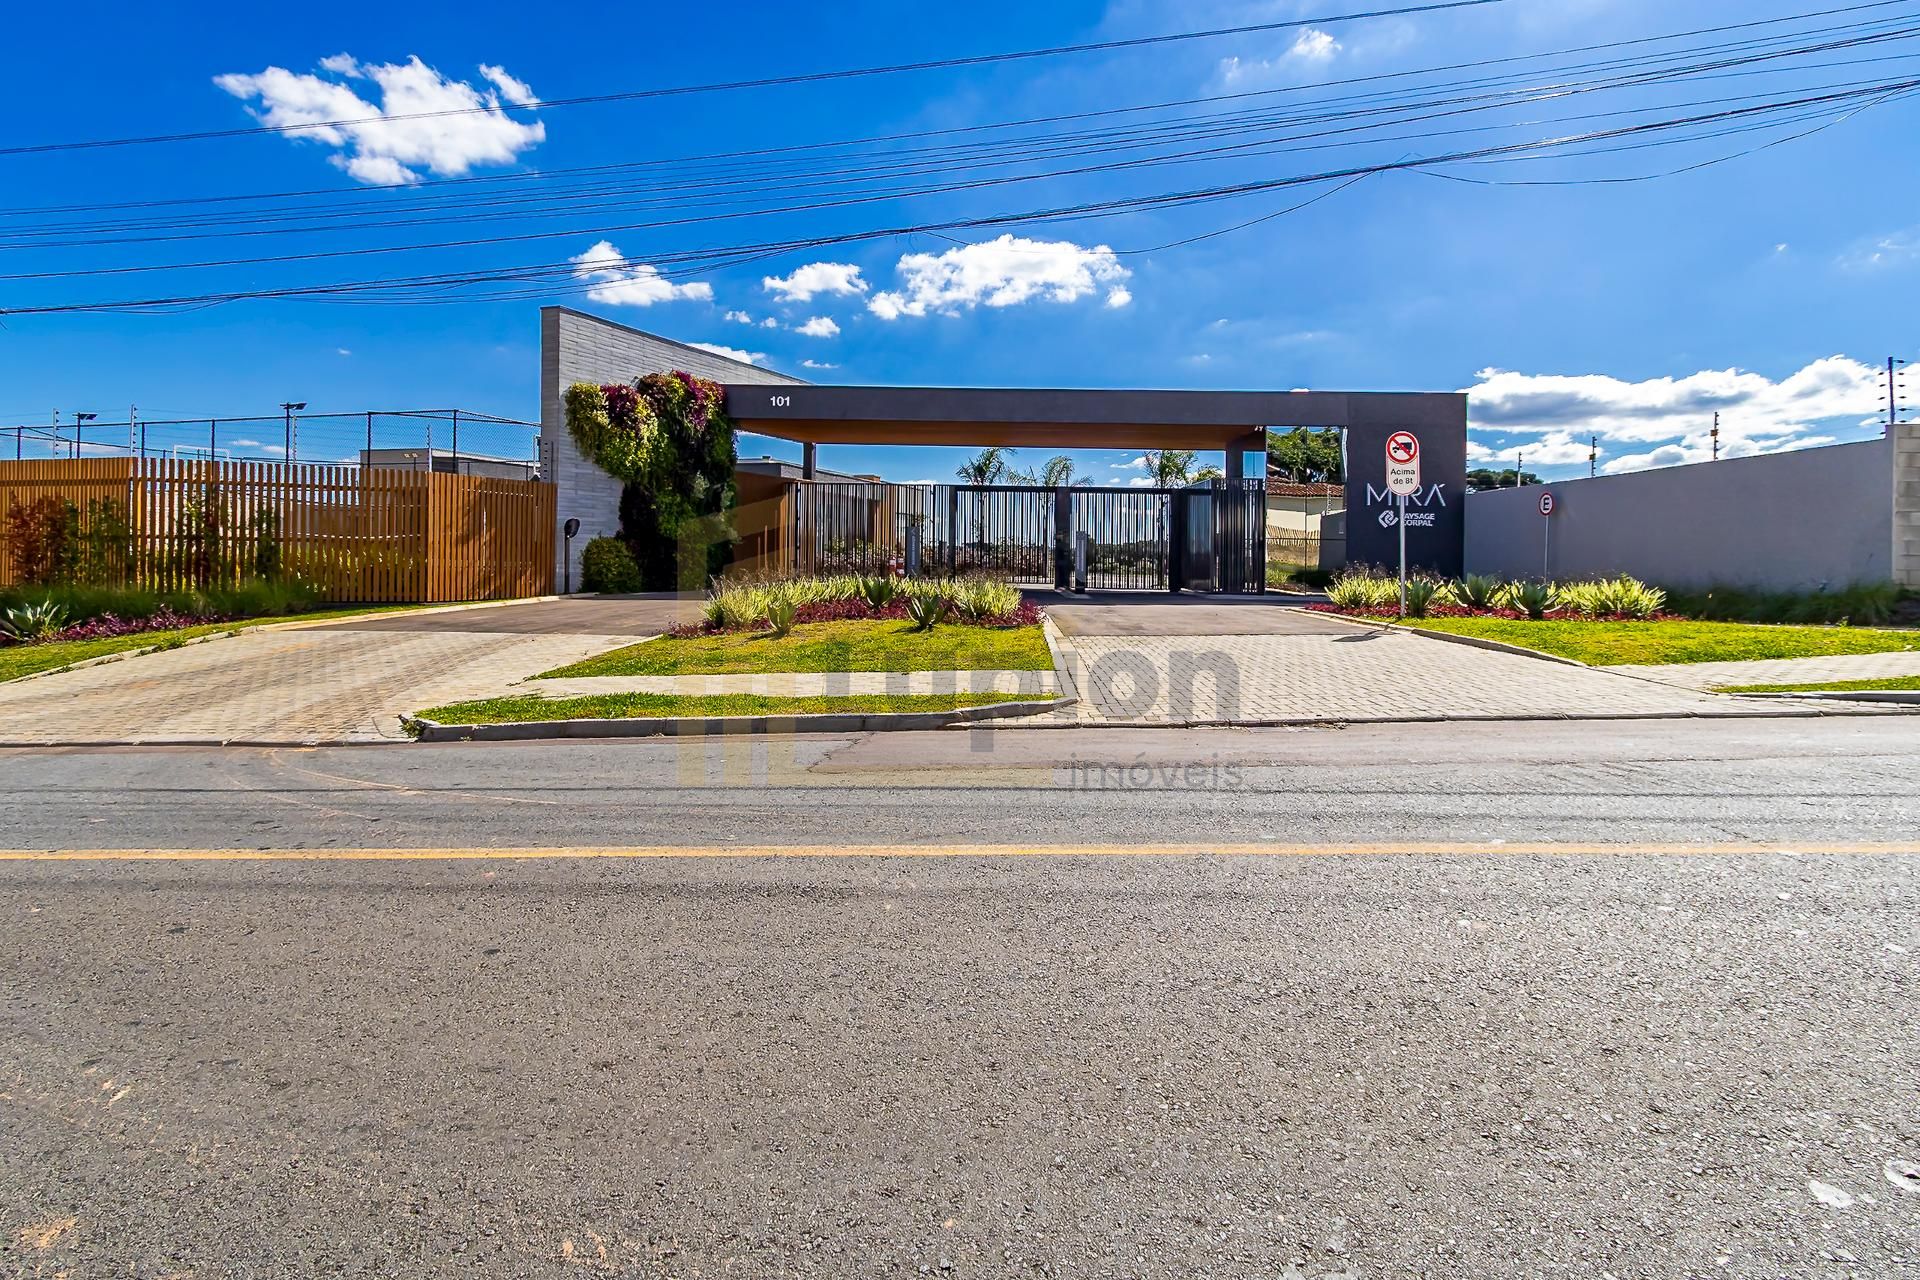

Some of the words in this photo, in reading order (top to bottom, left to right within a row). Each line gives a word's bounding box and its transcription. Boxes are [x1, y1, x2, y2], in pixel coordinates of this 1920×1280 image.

[770, 395, 790, 407] 101
[1390, 468, 1416, 476] Acima
[1393, 477, 1404, 485] de
[1543, 497, 1550, 511] E
[1404, 513, 1436, 521] AYSAGE
